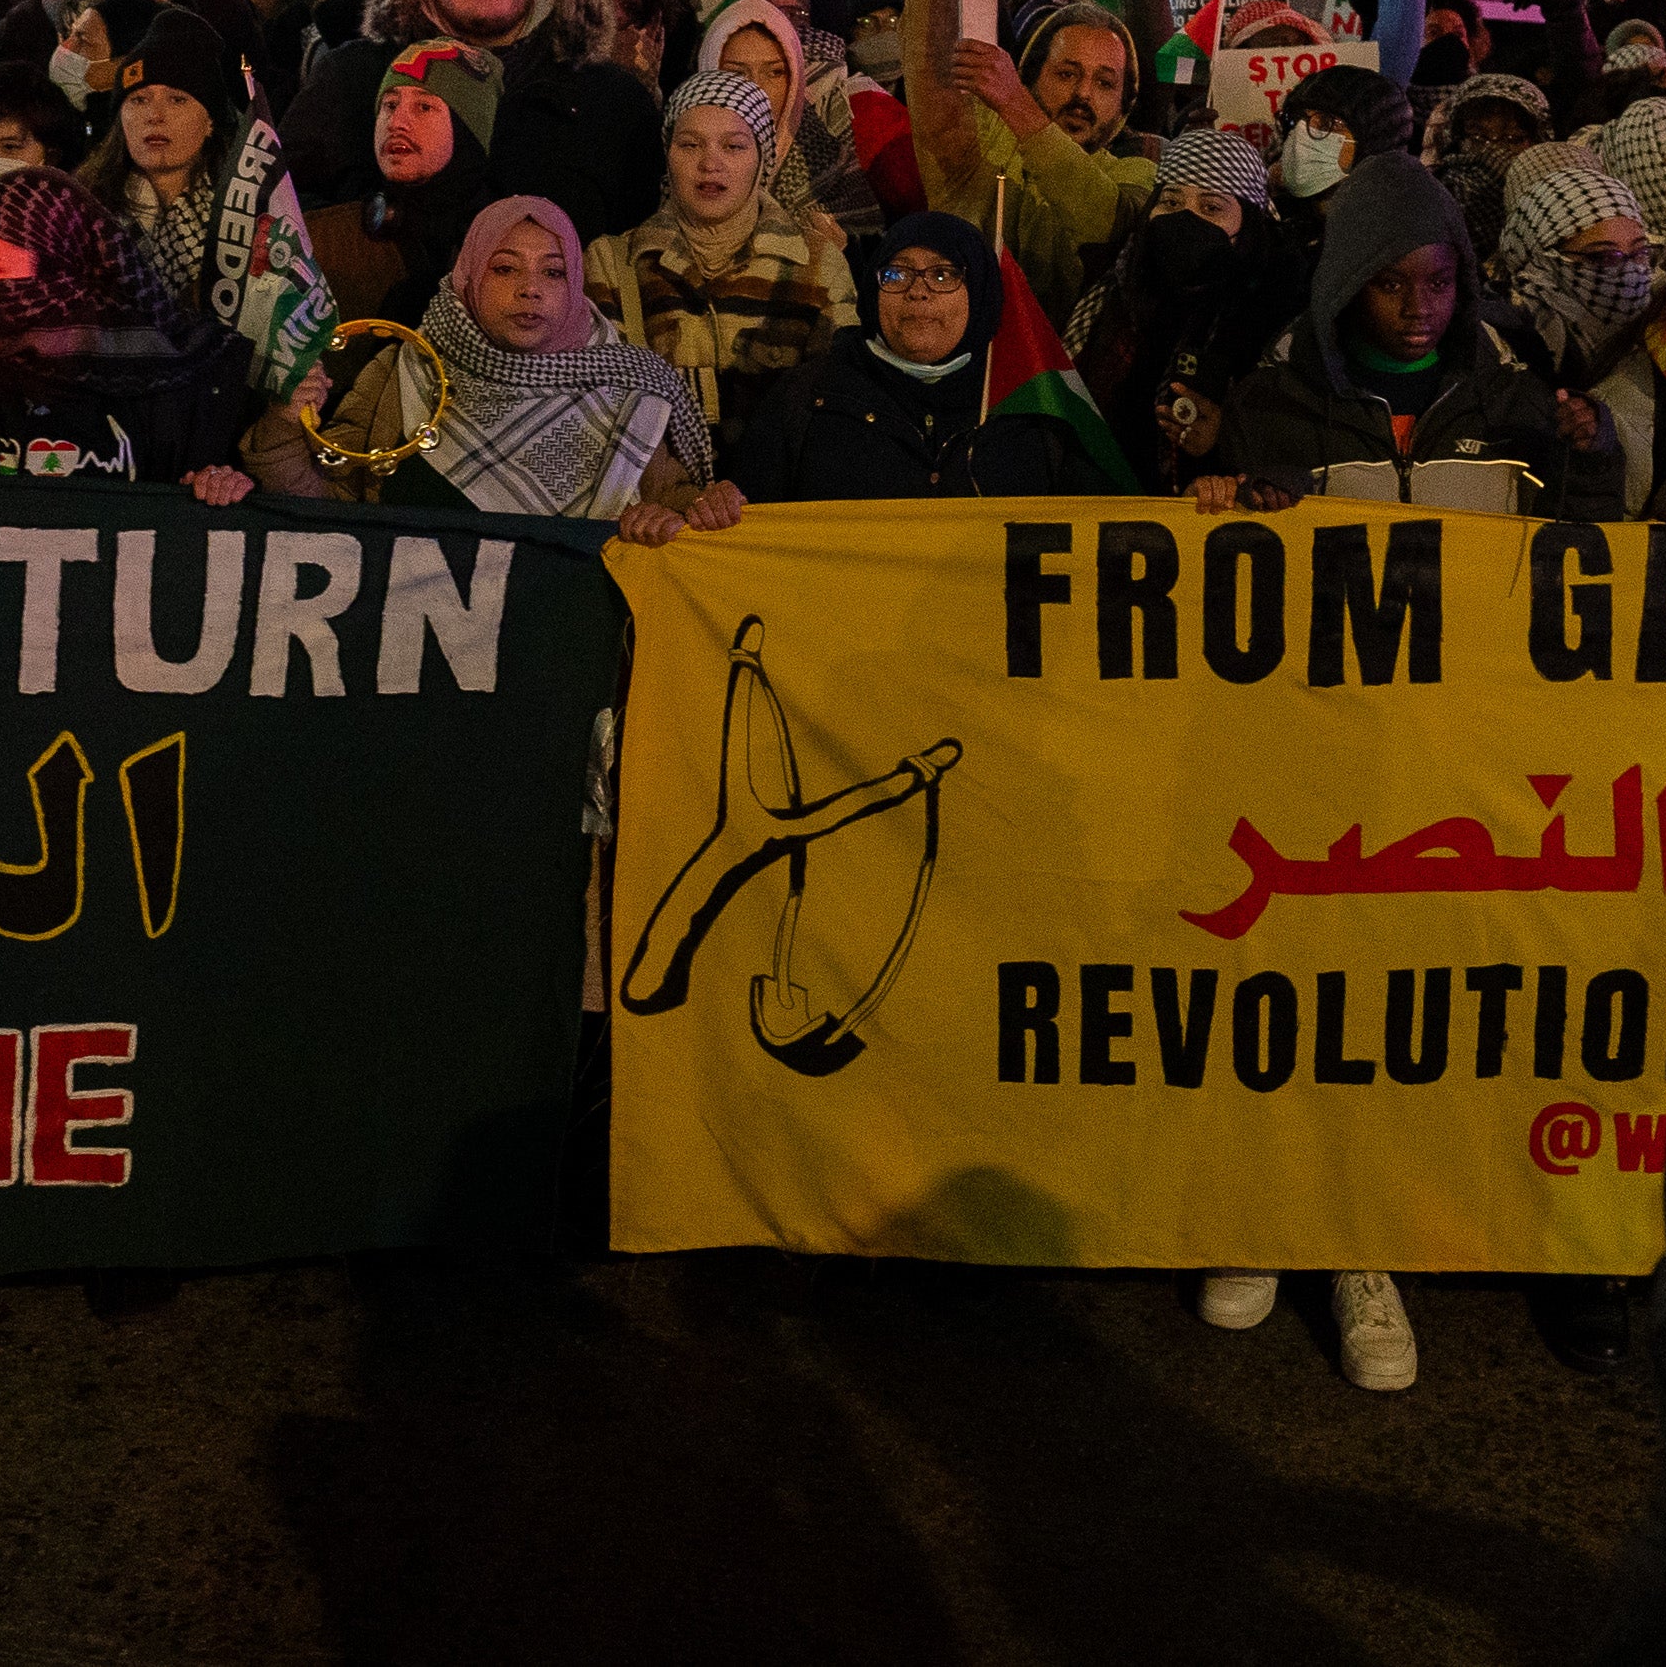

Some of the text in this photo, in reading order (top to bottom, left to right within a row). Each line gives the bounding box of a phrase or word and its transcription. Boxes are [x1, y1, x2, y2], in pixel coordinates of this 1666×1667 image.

[1247, 52, 1338, 86] STOP
[210, 118, 282, 326] FREEDO
[1004, 520, 1442, 688] FROM
